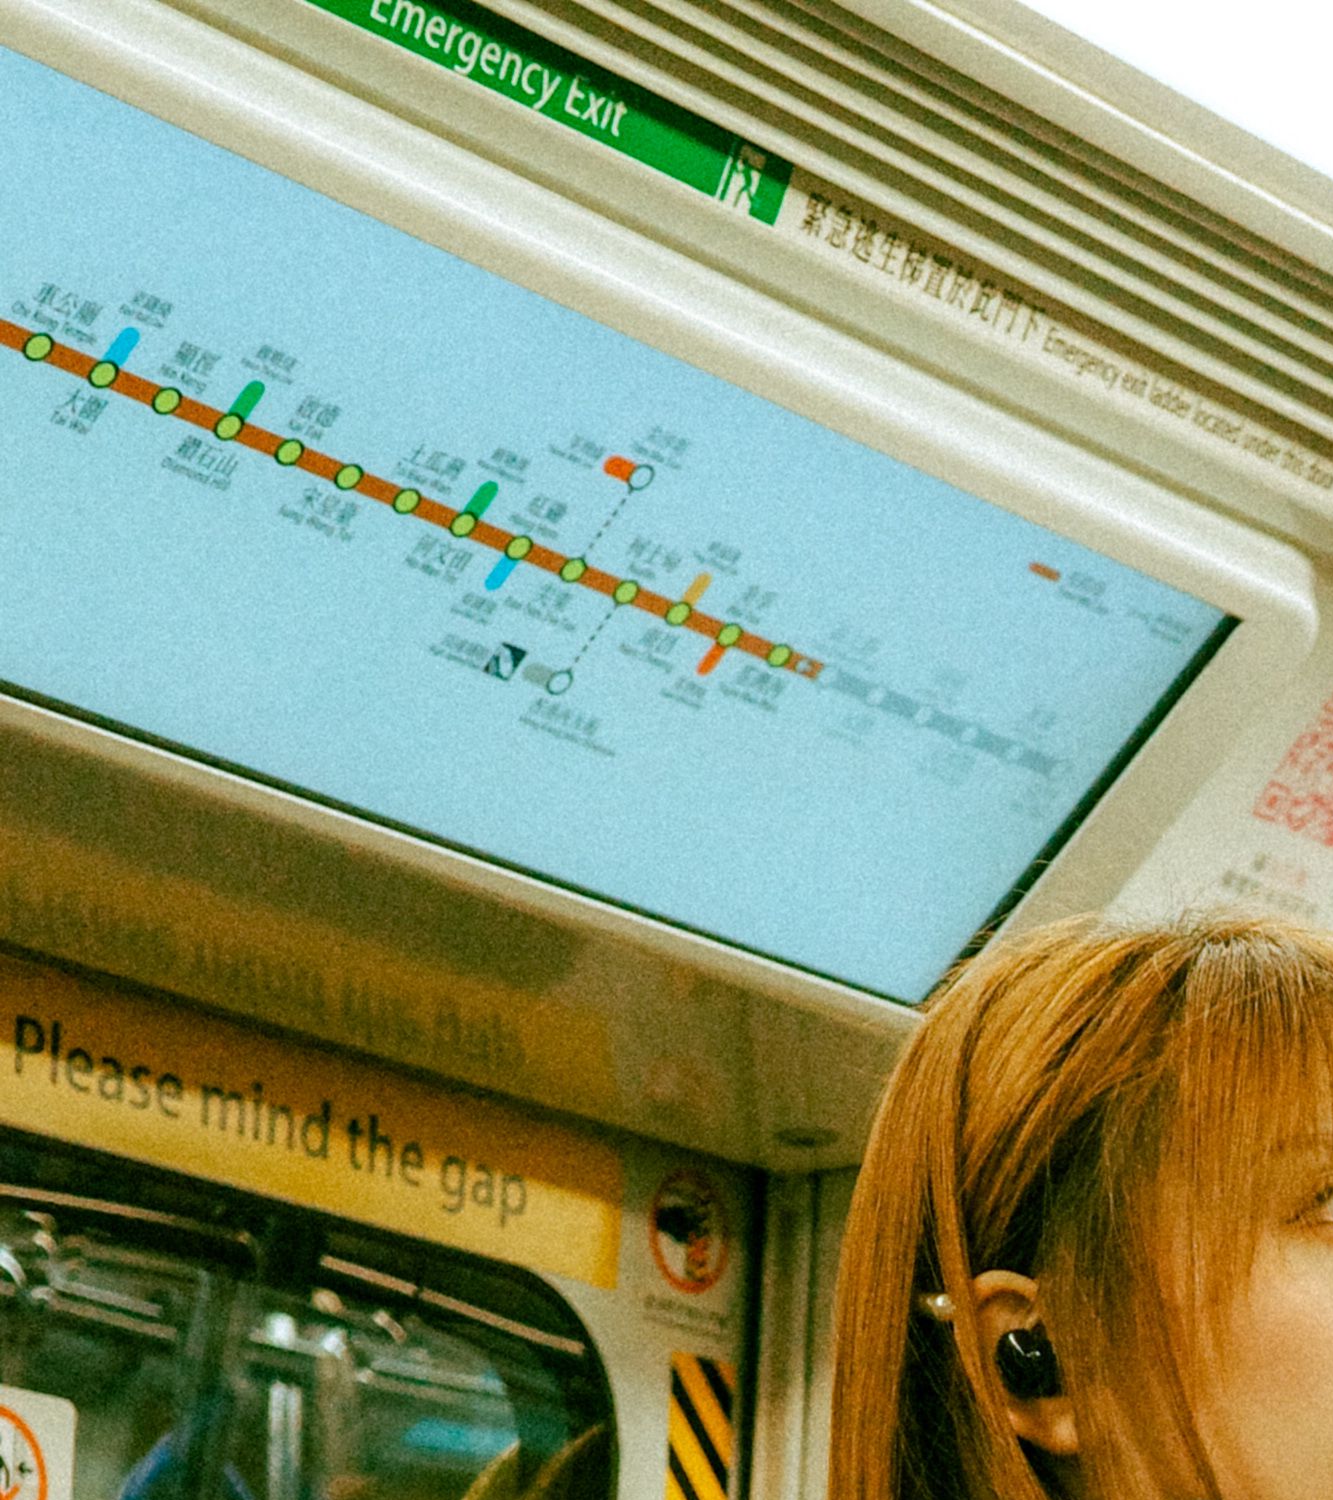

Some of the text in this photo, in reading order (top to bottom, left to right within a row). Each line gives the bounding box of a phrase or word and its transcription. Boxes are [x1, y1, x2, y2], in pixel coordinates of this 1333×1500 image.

[370, 0, 627, 137] Emergency Exit
[1042, 326, 1122, 390] Emergency
[1121, 371, 1149, 400] exit
[1149, 374, 1193, 419] ladder
[14, 1014, 528, 1229] Please mind the gap
